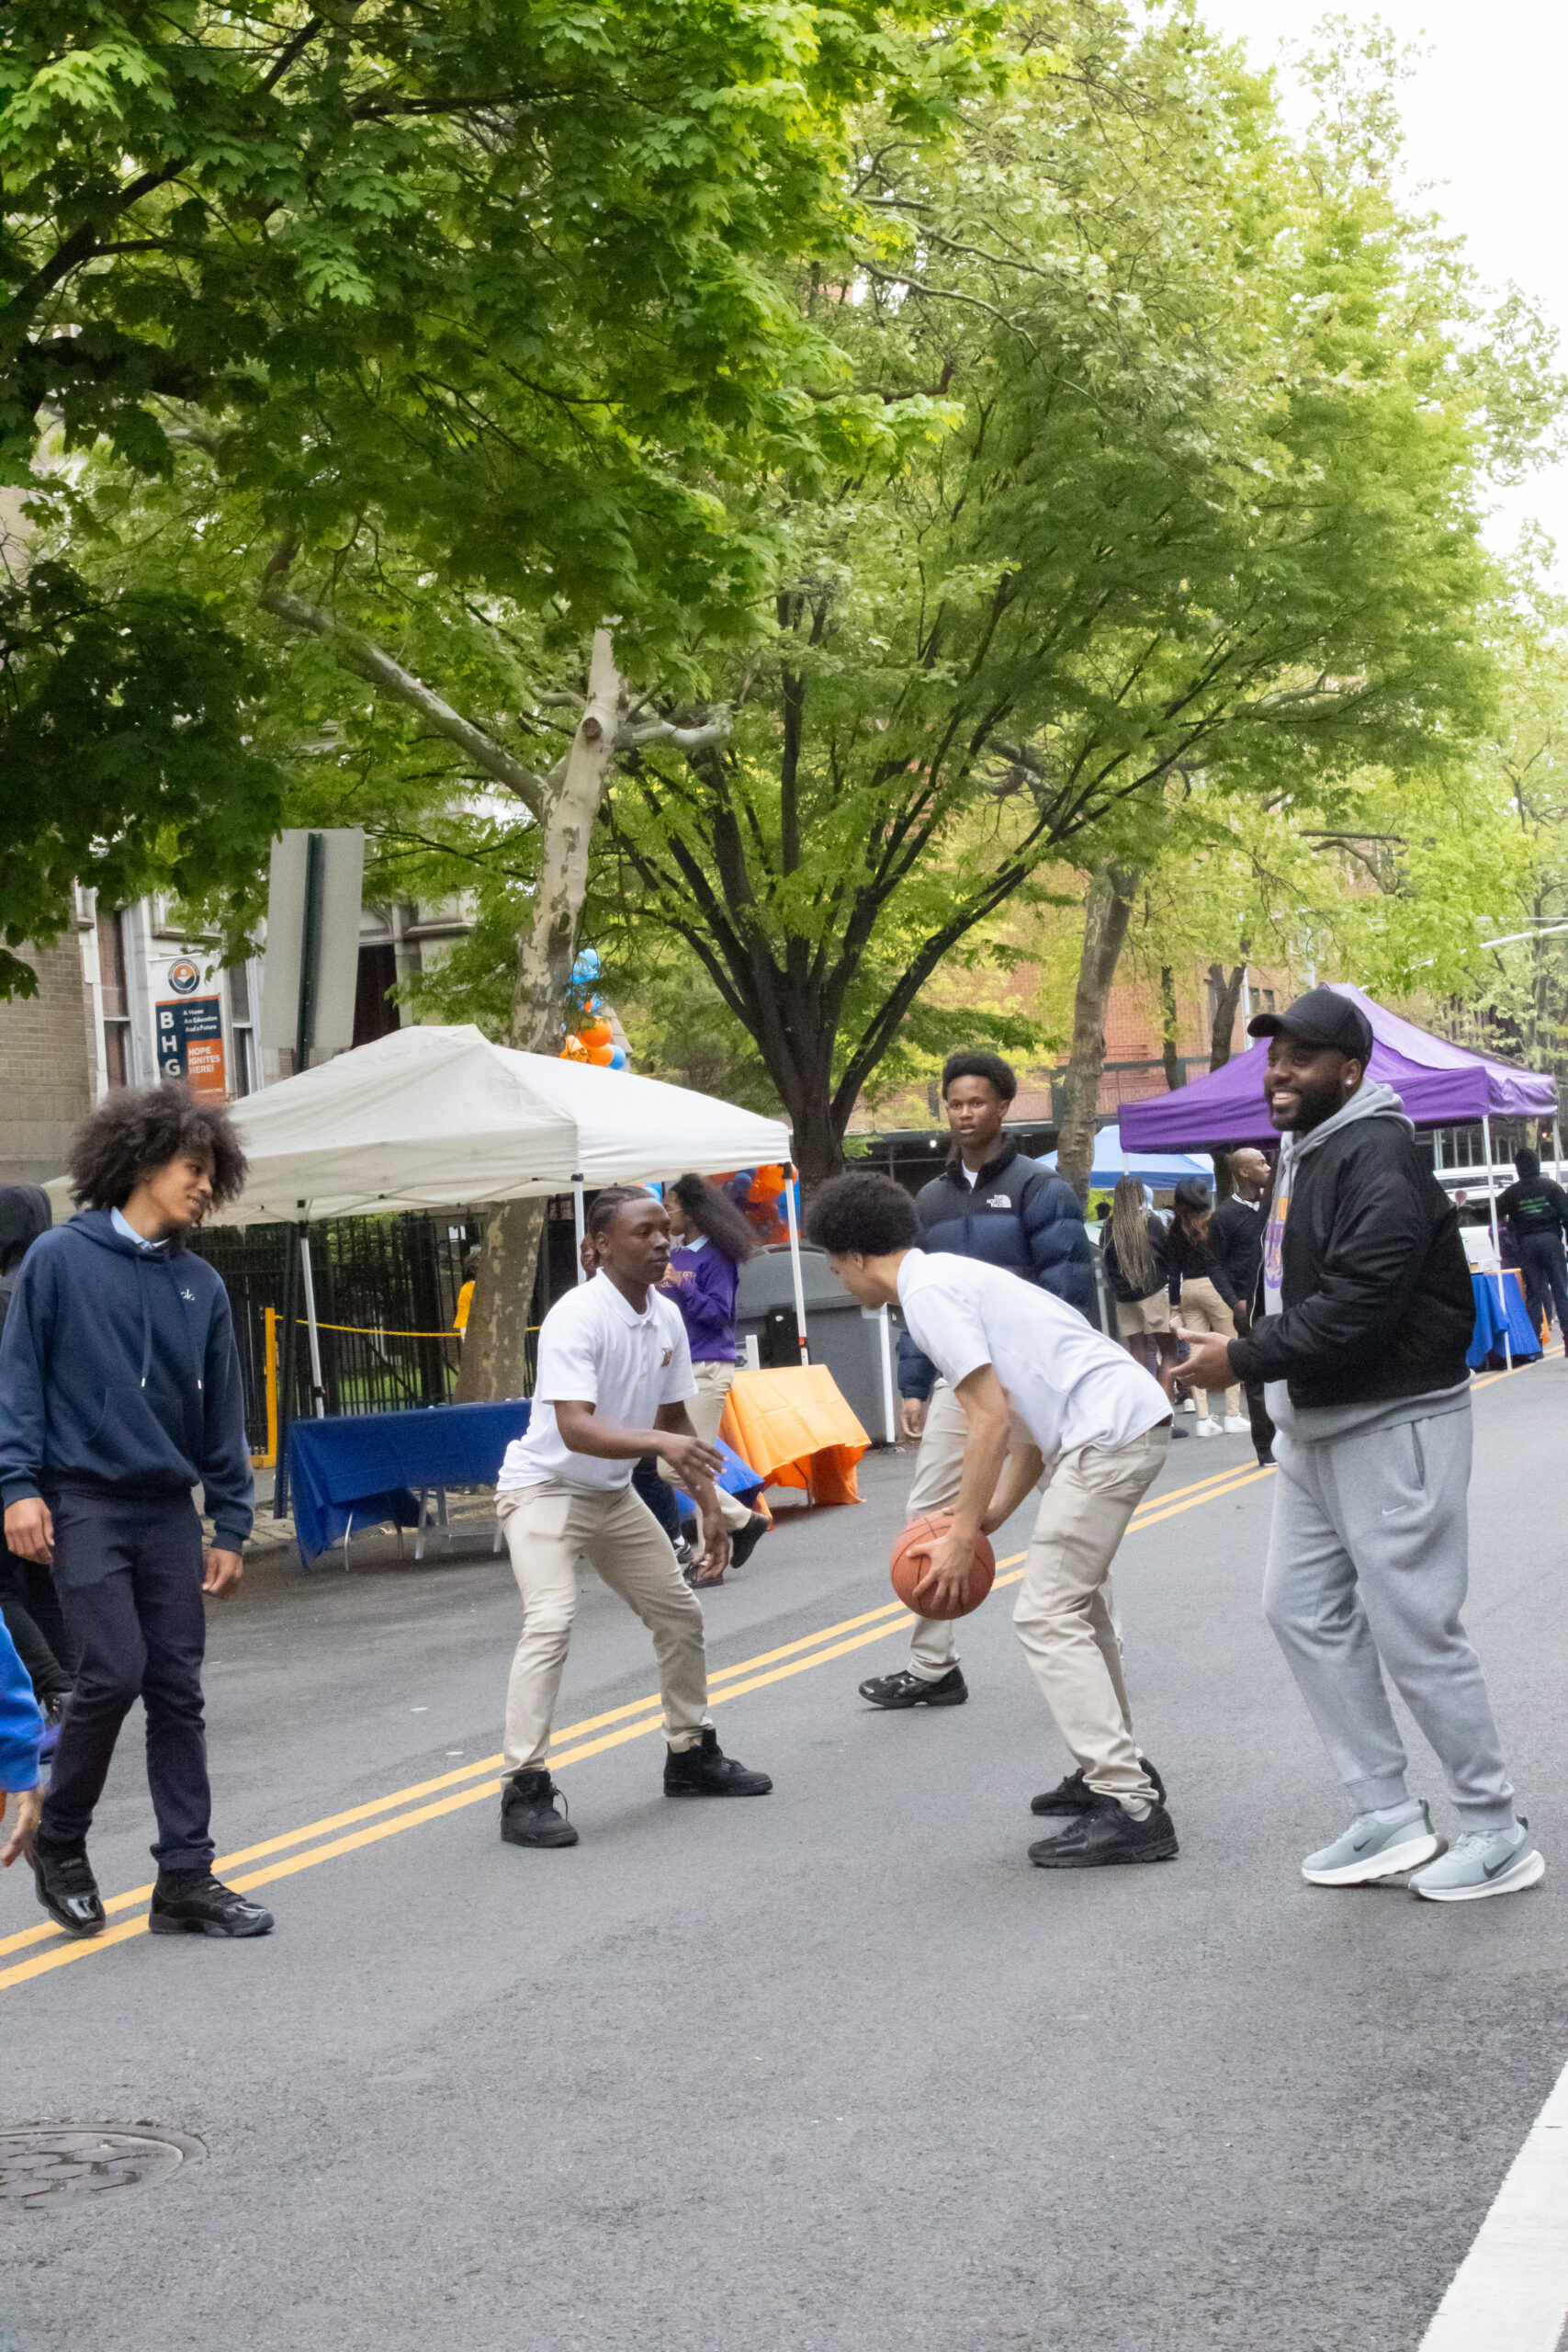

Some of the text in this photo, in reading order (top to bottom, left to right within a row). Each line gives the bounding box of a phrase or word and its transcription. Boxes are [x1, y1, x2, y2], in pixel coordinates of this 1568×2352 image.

[188, 1046, 210, 1055] HOPE
[188, 1055, 220, 1065] IGNITES
[189, 1065, 213, 1073] HERE!
